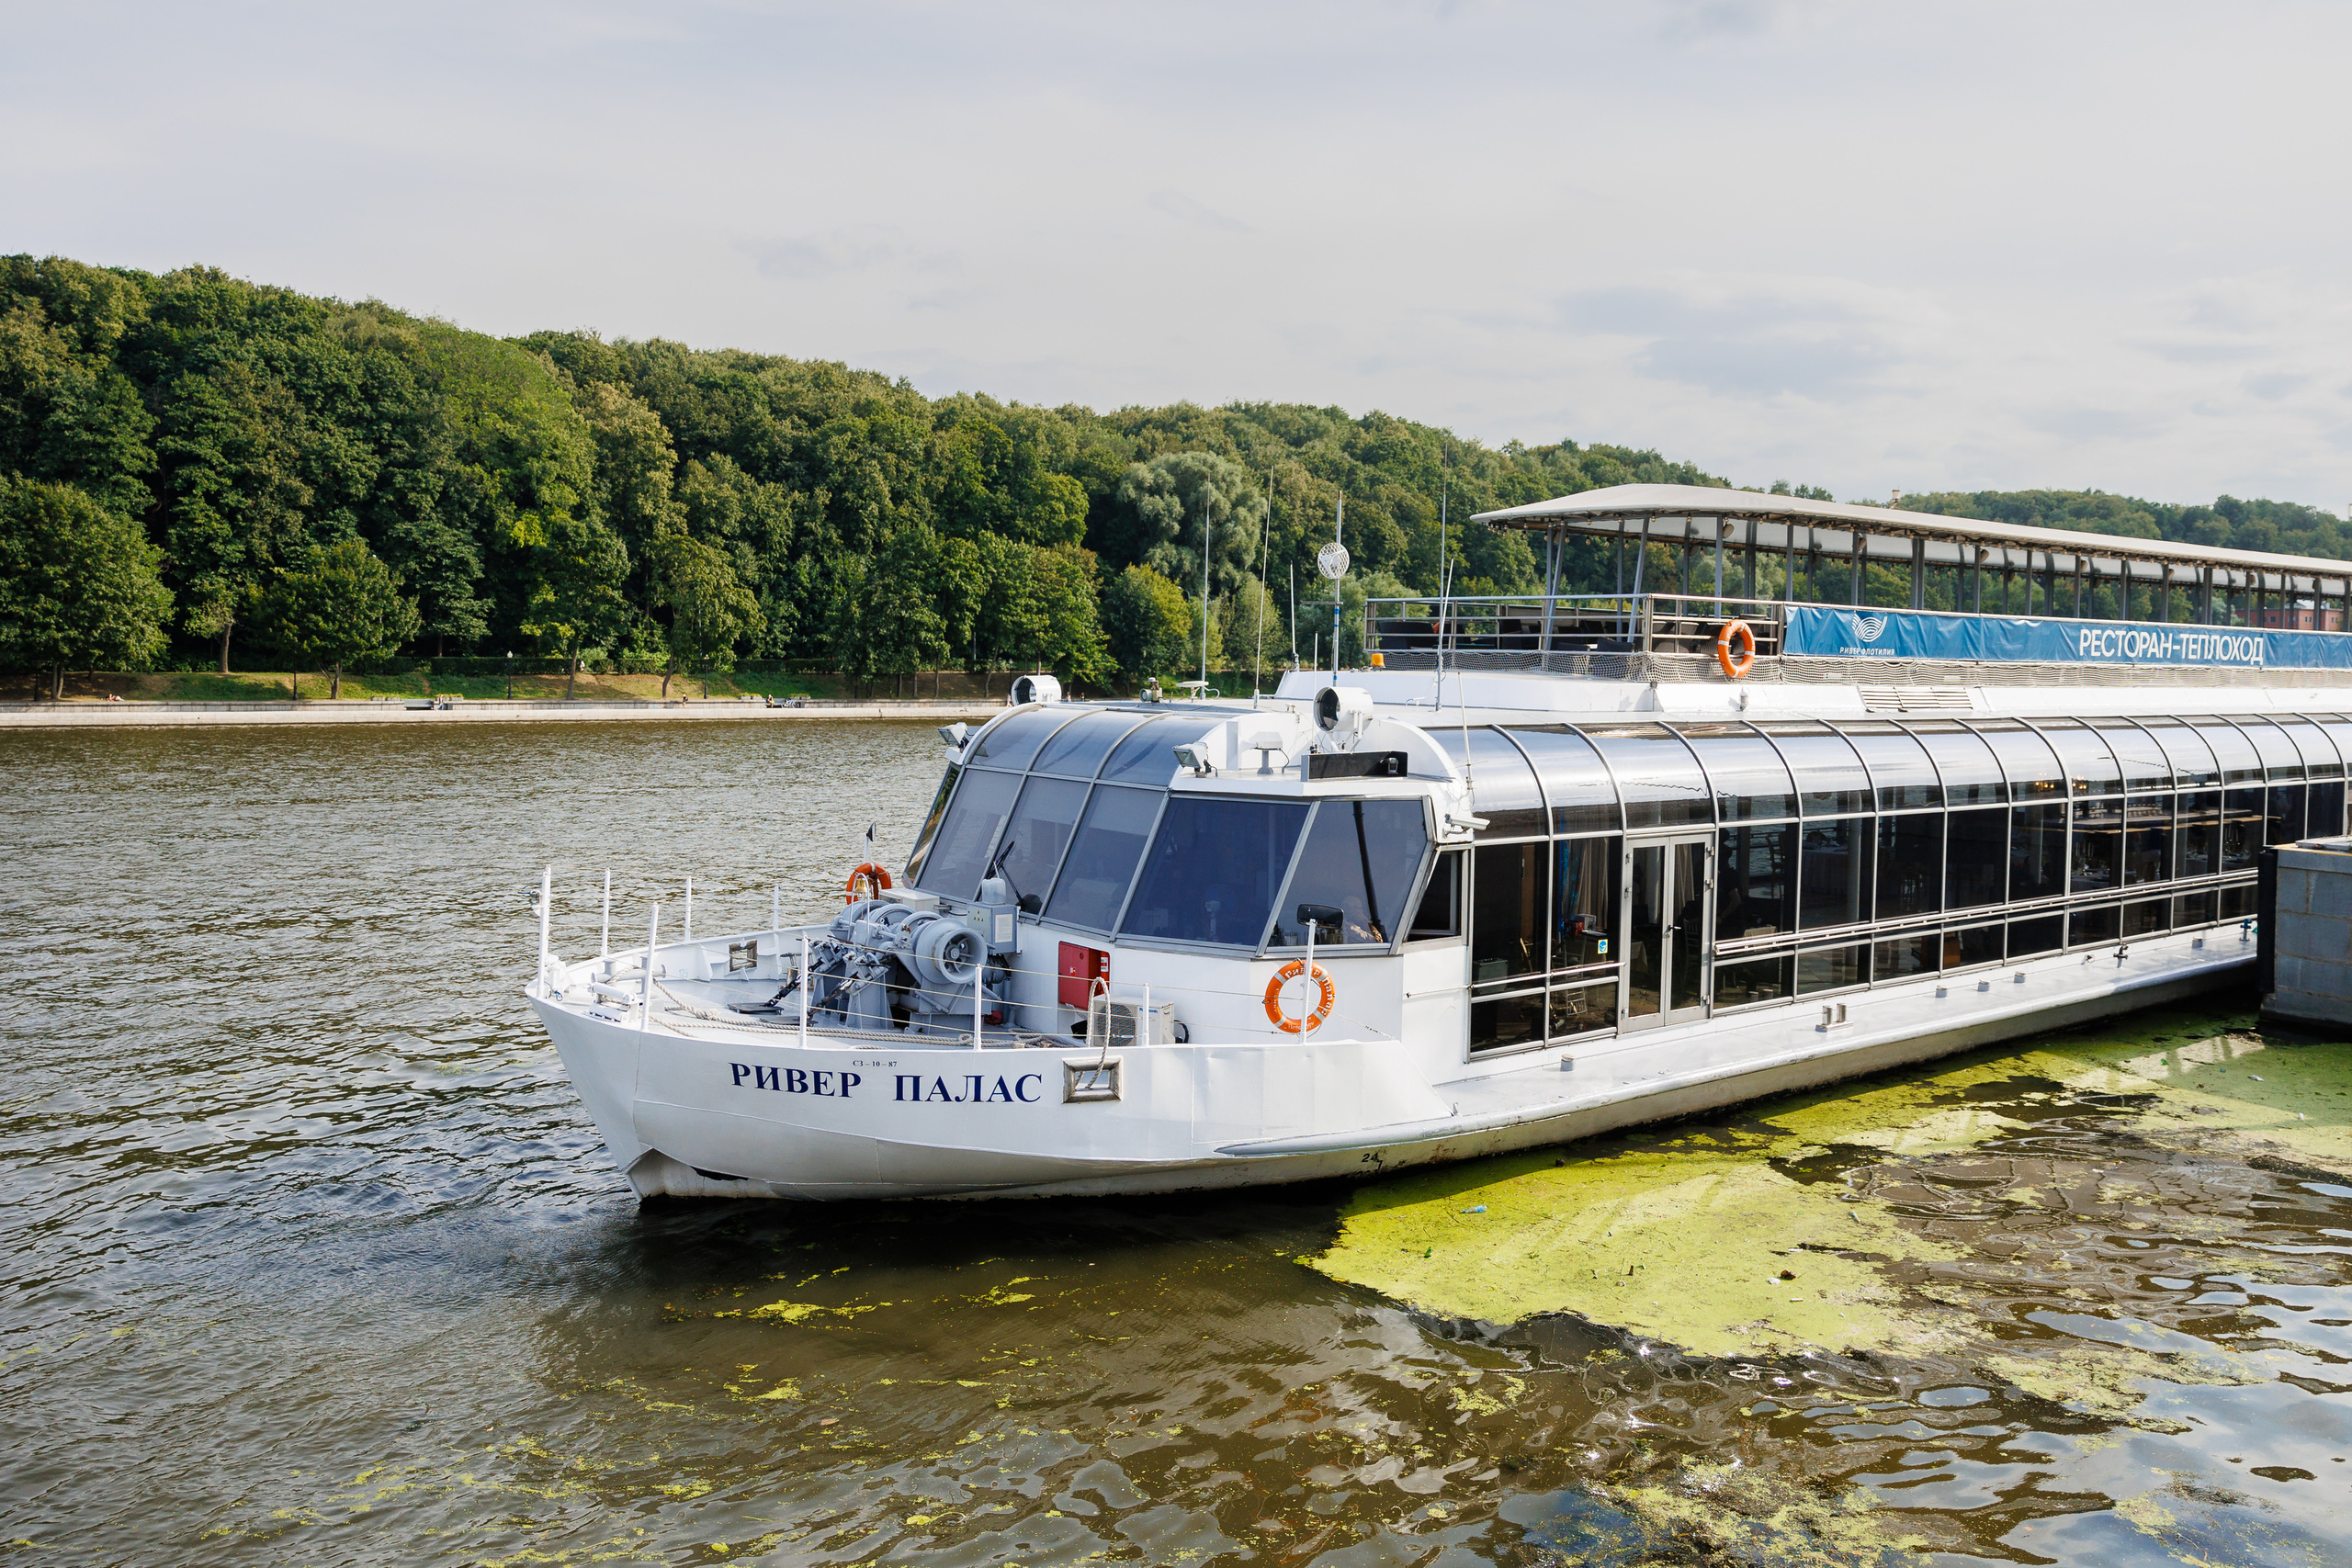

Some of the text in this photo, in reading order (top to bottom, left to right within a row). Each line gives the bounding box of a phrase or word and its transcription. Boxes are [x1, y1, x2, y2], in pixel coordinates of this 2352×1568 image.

[1839, 647, 1895, 656] РИВЕР ФЛОТИЛИЯ
[2079, 628, 2264, 665] РЕСТОРАН-ТЕПЛОХОД
[728, 1062, 1043, 1102] РИВЕР ПАЛАС
